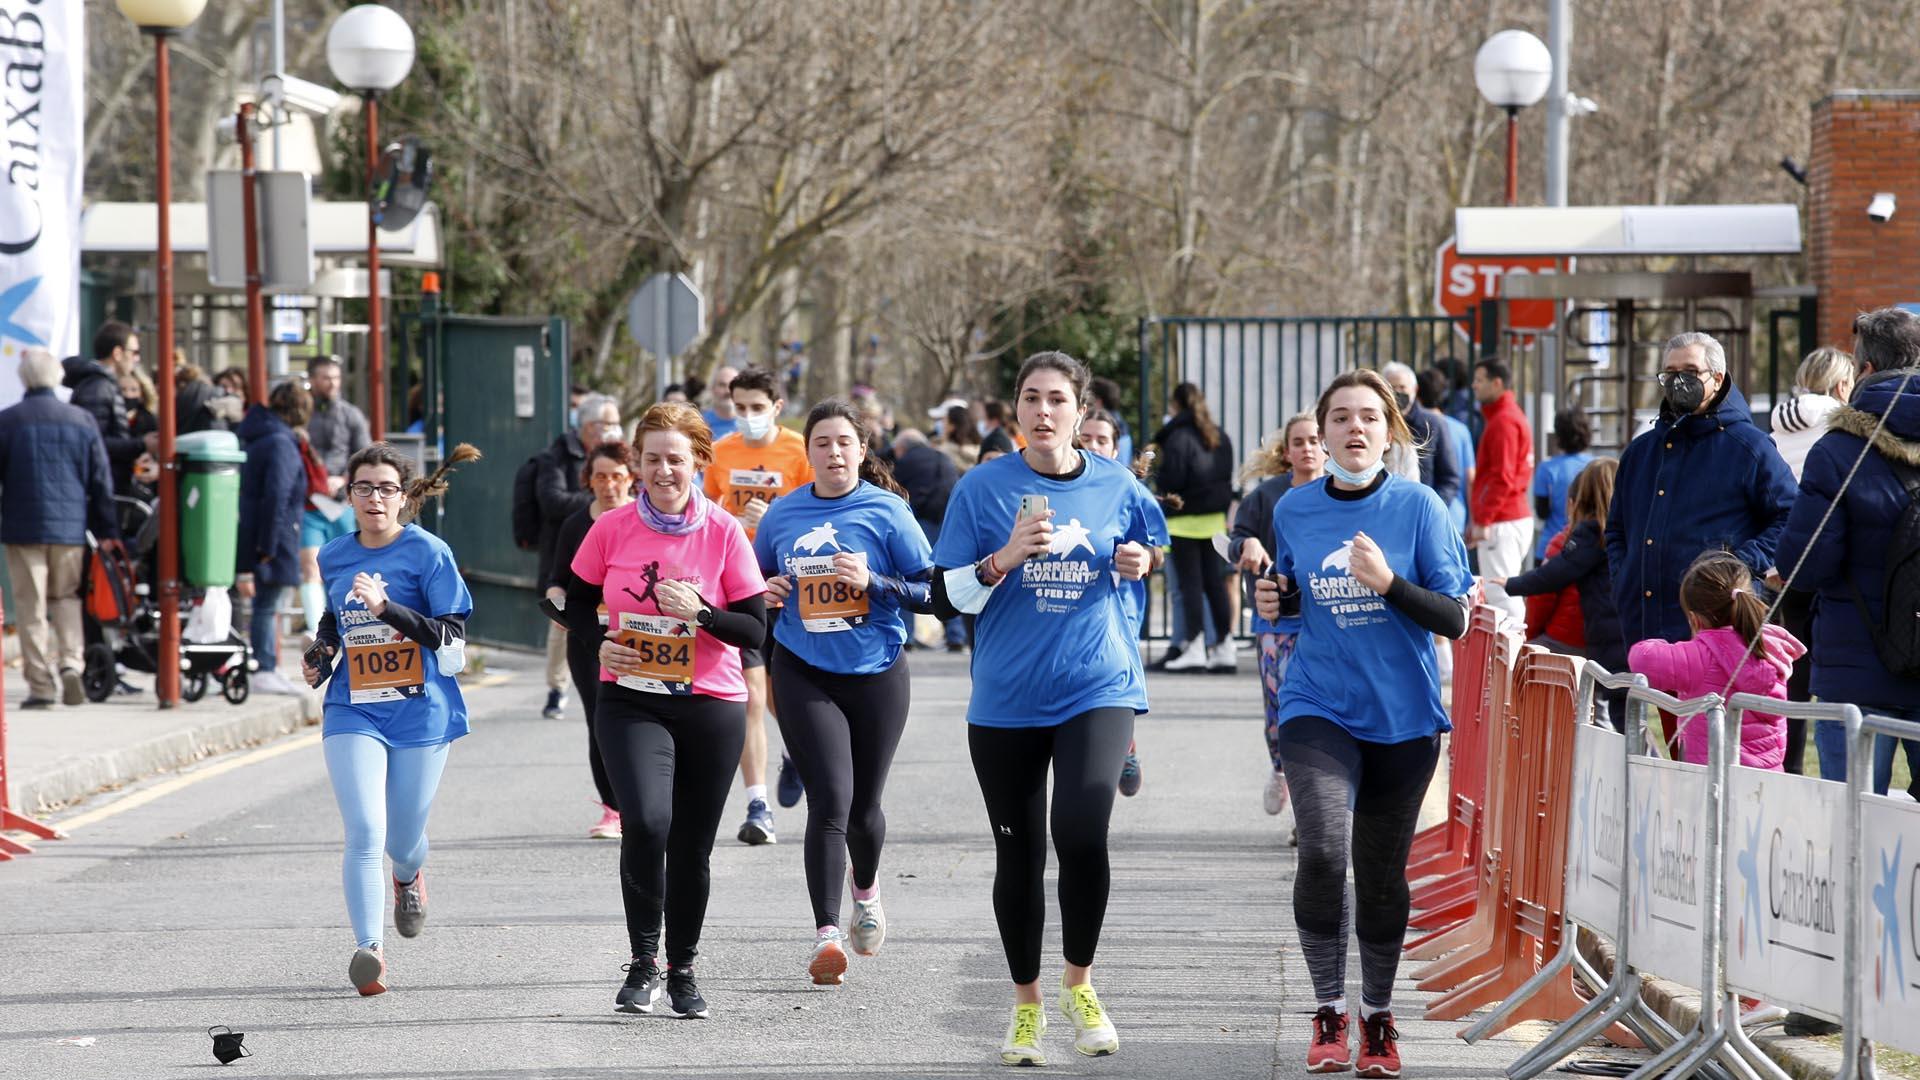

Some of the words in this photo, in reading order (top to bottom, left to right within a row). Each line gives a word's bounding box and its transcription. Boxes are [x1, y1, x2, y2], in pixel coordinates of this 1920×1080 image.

[0, 0, 45, 255] CaixaB
[1448, 263, 1556, 297] ST
[1023, 561, 1090, 573] CARRERA
[1310, 576, 1362, 589] CARRE
[1036, 588, 1043, 597] 6
[1044, 589, 1064, 598] FEB
[1322, 587, 1379, 600] VALIENT
[1331, 606, 1339, 614] 6
[1340, 603, 1360, 613] FEB
[627, 620, 653, 628] ARRERA
[630, 626, 662, 634] VALIENTES
[348, 633, 376, 641] CARRERA
[353, 647, 415, 675] 1087
[408, 686, 419, 694] 5K
[676, 683, 685, 691] 5K
[1769, 827, 1836, 934] CaixaBank
